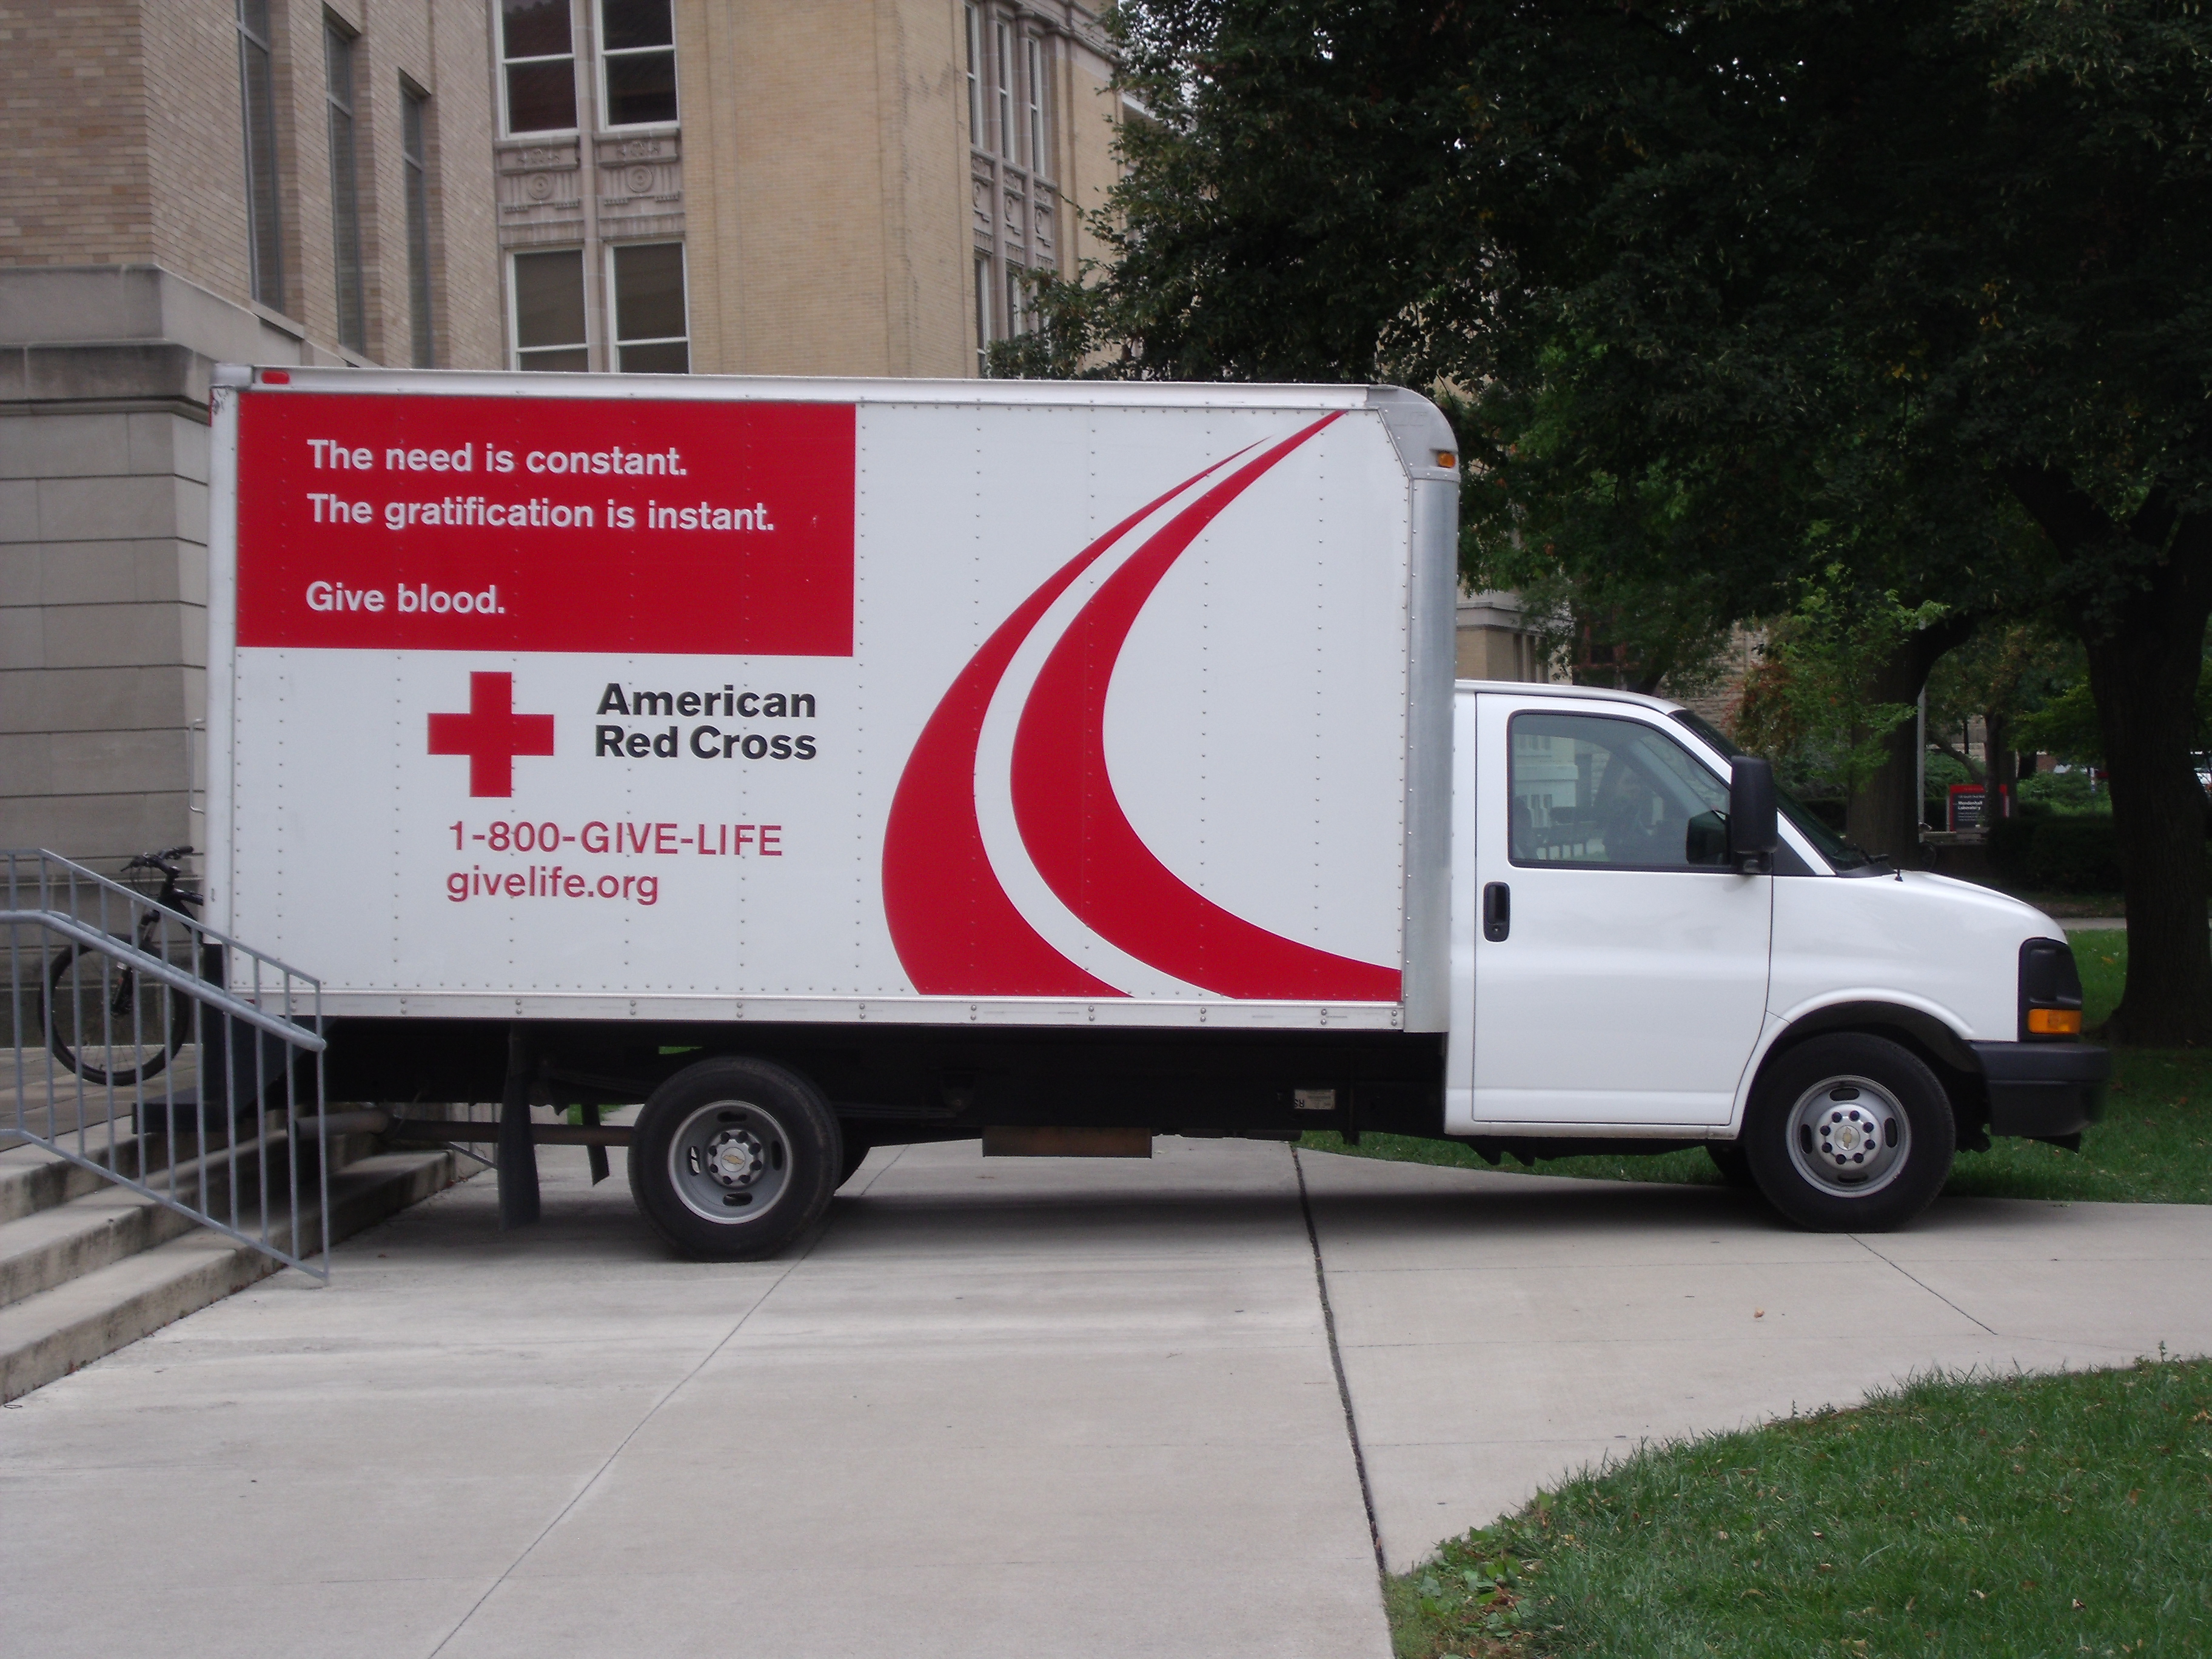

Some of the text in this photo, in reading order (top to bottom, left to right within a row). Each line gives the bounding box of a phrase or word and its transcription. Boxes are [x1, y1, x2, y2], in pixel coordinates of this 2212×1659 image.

[307, 439, 687, 475] The need is constant.
[307, 493, 774, 531] The gratification is instant.
[306, 580, 505, 614] Give blood.
[596, 682, 816, 718] American
[595, 725, 816, 760] Red Cross
[449, 821, 783, 856] 1-800-GIVE-LIFE
[447, 866, 659, 905] givelife.org
